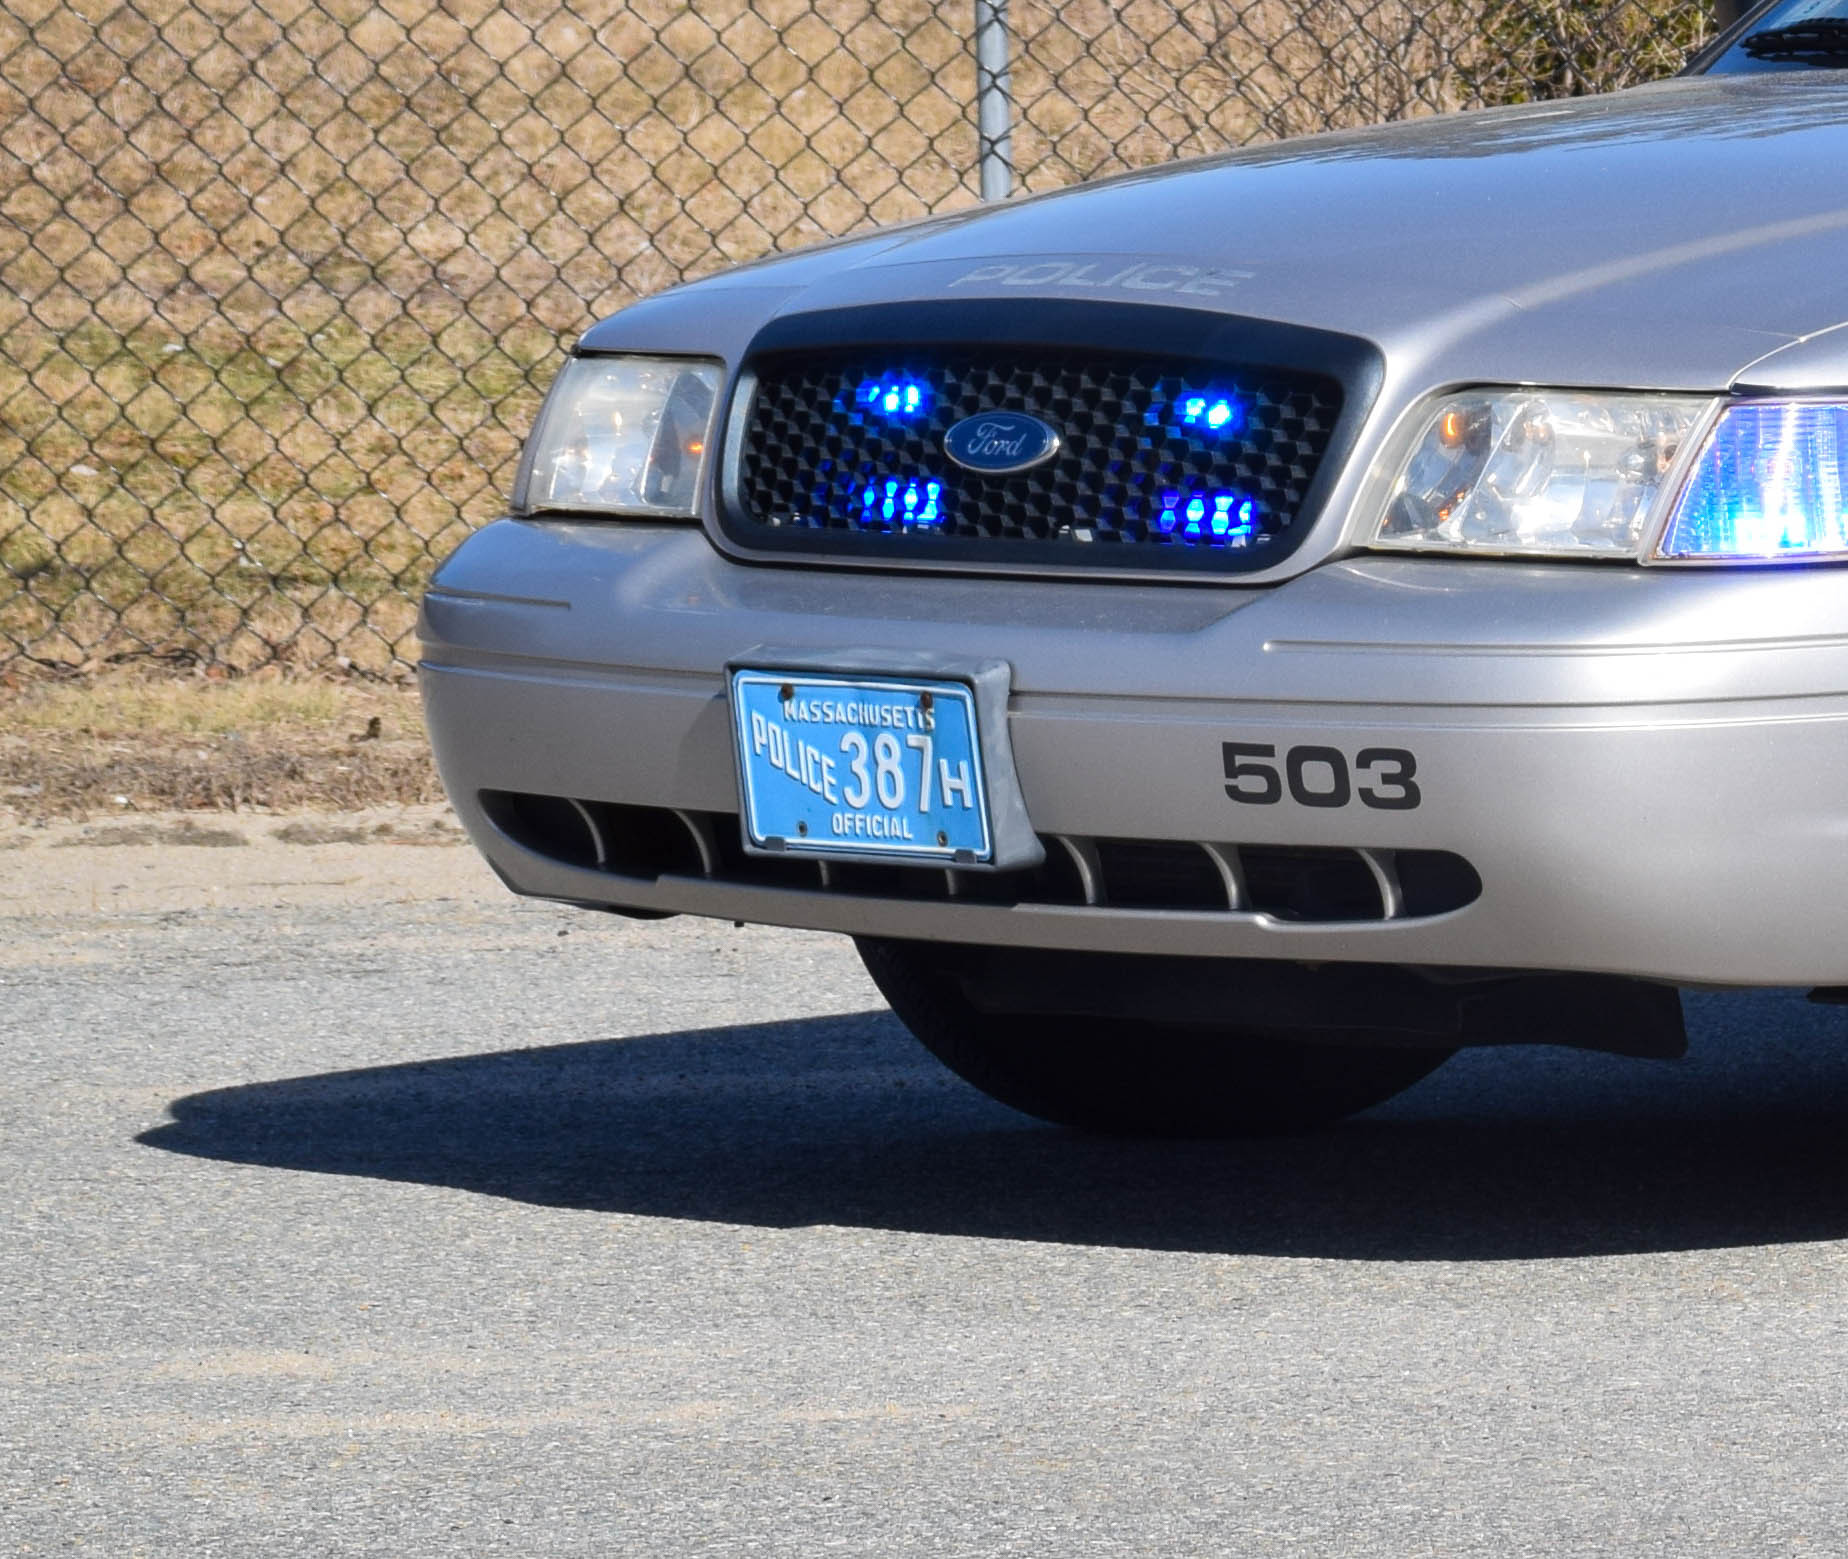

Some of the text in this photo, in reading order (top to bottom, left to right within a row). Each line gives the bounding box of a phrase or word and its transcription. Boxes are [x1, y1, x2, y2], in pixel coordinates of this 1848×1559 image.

[949, 262, 1256, 297] POLICE
[967, 422, 1028, 456] Ford
[783, 700, 936, 730] MASSACHUSETTS
[751, 710, 838, 805] POLICE
[1221, 741, 1422, 811] 503
[831, 812, 914, 840] OFFICIAL
